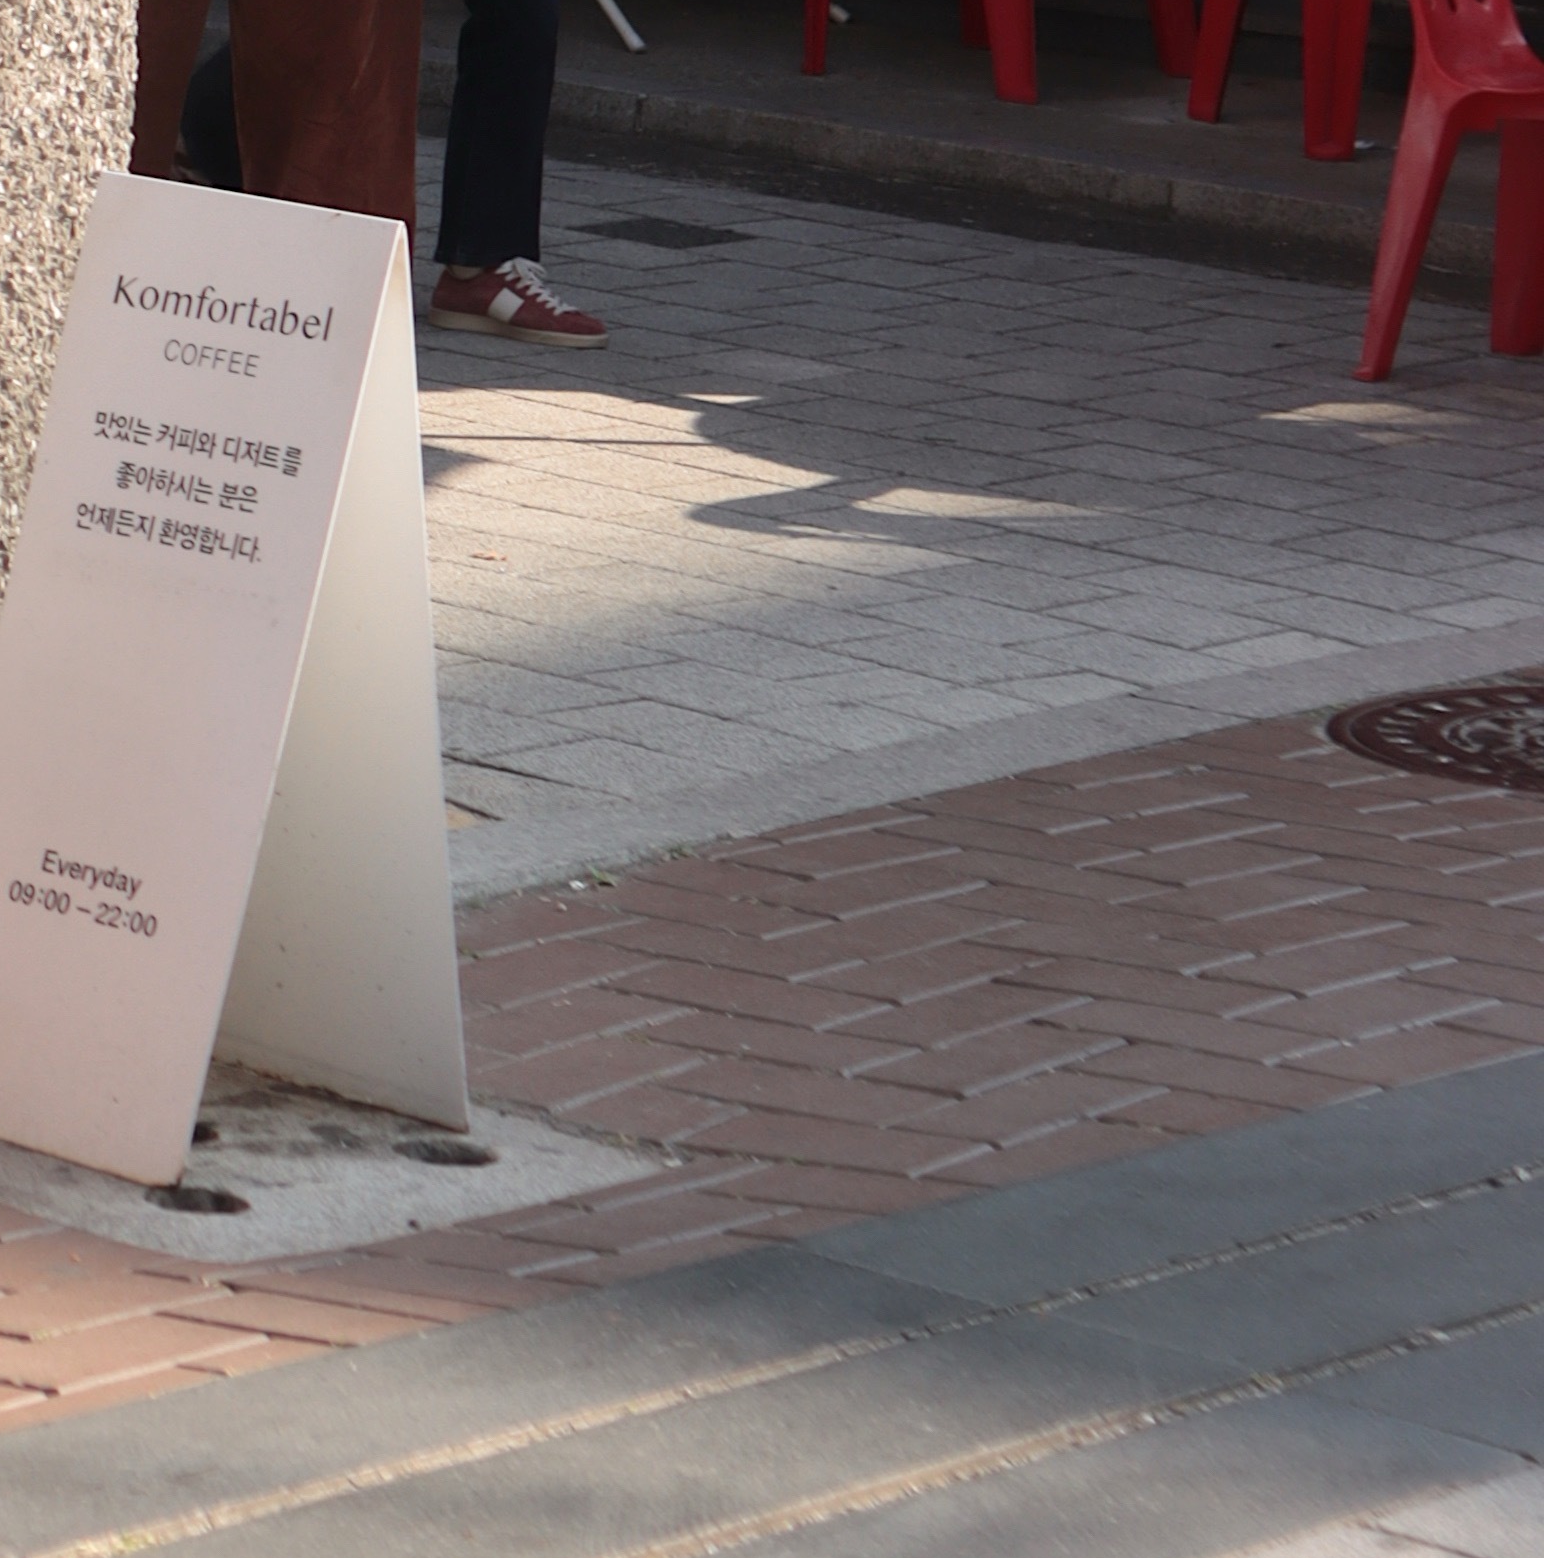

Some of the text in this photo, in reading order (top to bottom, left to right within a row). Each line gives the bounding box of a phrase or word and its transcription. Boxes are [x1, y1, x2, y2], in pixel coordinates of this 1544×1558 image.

[112, 275, 334, 341] Komfortabel
[163, 338, 261, 379] COFFEE
[93, 410, 303, 477] 맛있는 커피와 디저트를
[116, 460, 259, 514] 좋아하시는 분은
[76, 502, 262, 564] 언제든지 환영합니다.
[41, 848, 143, 901] Everyday
[8, 879, 71, 915] 09:00
[94, 901, 158, 937] 22:00
